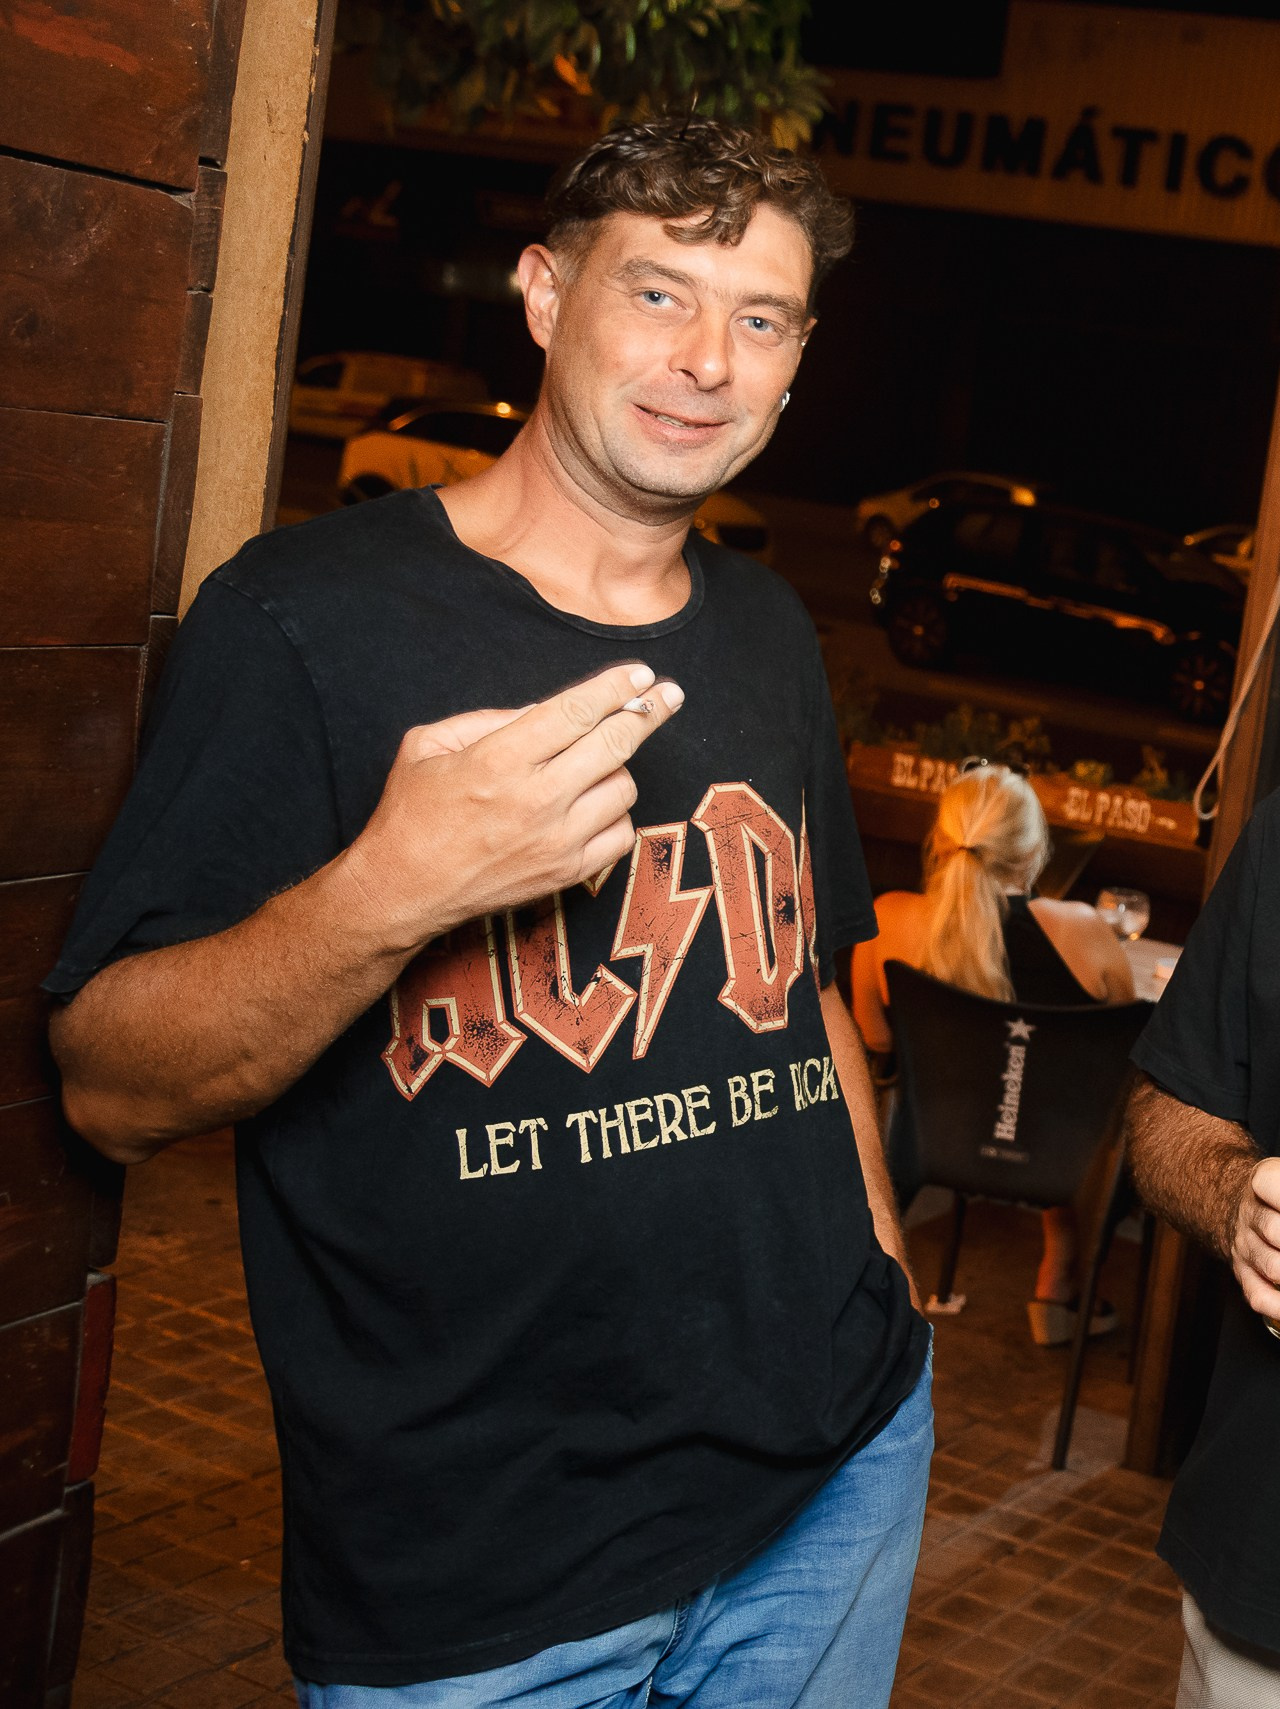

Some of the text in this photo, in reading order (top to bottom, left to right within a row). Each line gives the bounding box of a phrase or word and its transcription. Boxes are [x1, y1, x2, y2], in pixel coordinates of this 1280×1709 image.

[919, 758, 958, 794] PA
[1094, 792, 1151, 832] PASO
[455, 1118, 548, 1180] LET
[566, 1085, 716, 1163] THERE
[728, 1069, 778, 1127] BE
[994, 1042, 1026, 1141] Heineken
